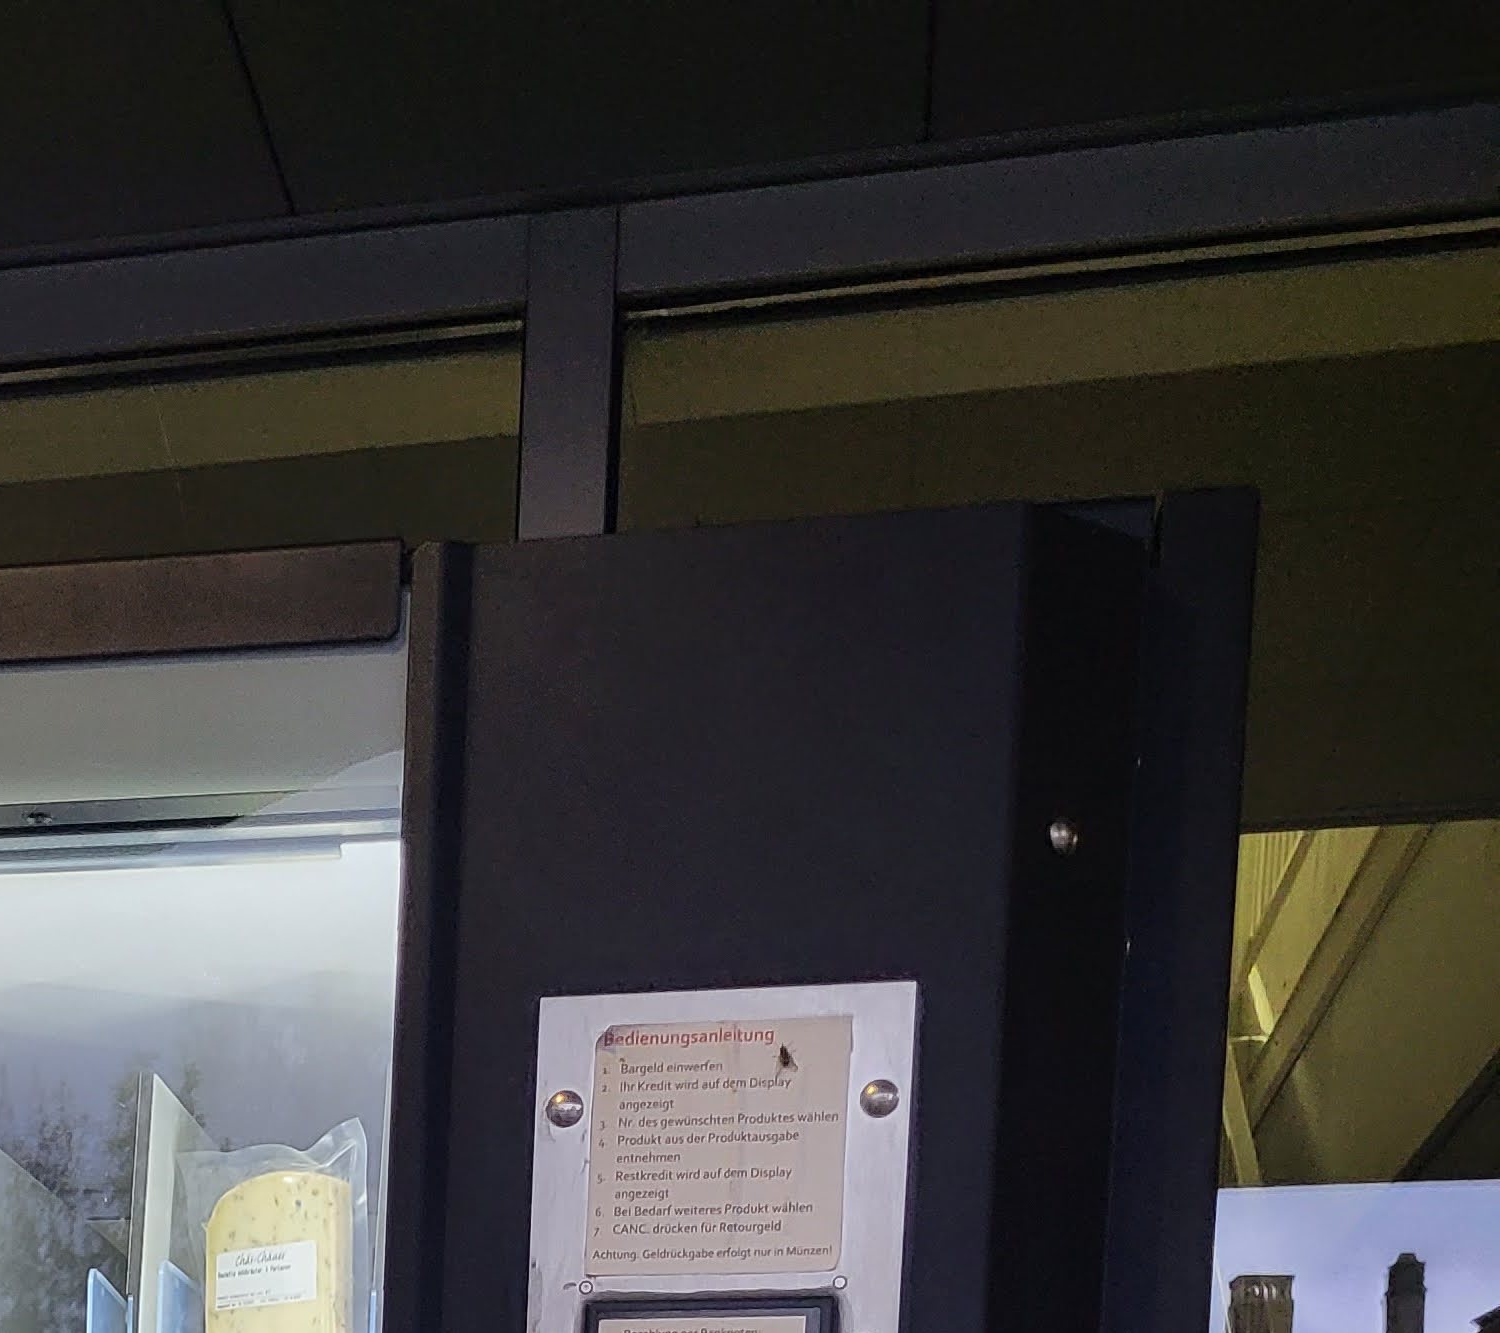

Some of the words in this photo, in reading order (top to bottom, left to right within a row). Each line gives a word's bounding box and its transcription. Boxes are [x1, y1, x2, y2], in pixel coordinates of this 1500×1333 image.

[604, 1028, 774, 1049] Bedienungsanleitung
[621, 1062, 664, 1077] Bargeld
[666, 1061, 723, 1072] einwerfen
[620, 1079, 635, 1092] Ihr
[637, 1078, 672, 1091] Kredit
[675, 1078, 699, 1090] wird
[701, 1077, 720, 1089] auf
[723, 1078, 747, 1089] dem
[750, 1077, 791, 1090] Display
[619, 1097, 674, 1112] angezeigt
[618, 1117, 635, 1129] Nr.
[638, 1116, 657, 1128] des
[660, 1115, 735, 1131] gewünschten
[737, 1112, 794, 1126] Produktes
[797, 1111, 838, 1124] wählen
[618, 1134, 662, 1147] Produkt
[664, 1135, 684, 1145] aus
[687, 1132, 706, 1145] der
[708, 1130, 799, 1146] Produktausgabe
[616, 1152, 681, 1163] entnehmen
[615, 1169, 673, 1182] Restkredit
[676, 1168, 700, 1180] wird
[703, 1167, 722, 1179] auf
[724, 1168, 749, 1179] dem
[750, 1167, 791, 1180] Display
[614, 1188, 669, 1202] angezeigt
[614, 1206, 632, 1217] Bei
[634, 1204, 672, 1217] Bedarf
[674, 1204, 722, 1216] weiteres
[724, 1202, 769, 1215] Produkt
[772, 1202, 812, 1215] wählen
[613, 1223, 648, 1235] CANC.
[652, 1223, 698, 1234] drücken
[700, 1221, 717, 1233] für
[719, 1221, 782, 1234] Retourgeld
[642, 1247, 714, 1261] Geldrückgabe
[716, 1247, 751, 1260] erfolgt
[753, 1248, 771, 1258] nur
[774, 1248, 783, 1257] in
[786, 1246, 832, 1257] Münzen!
